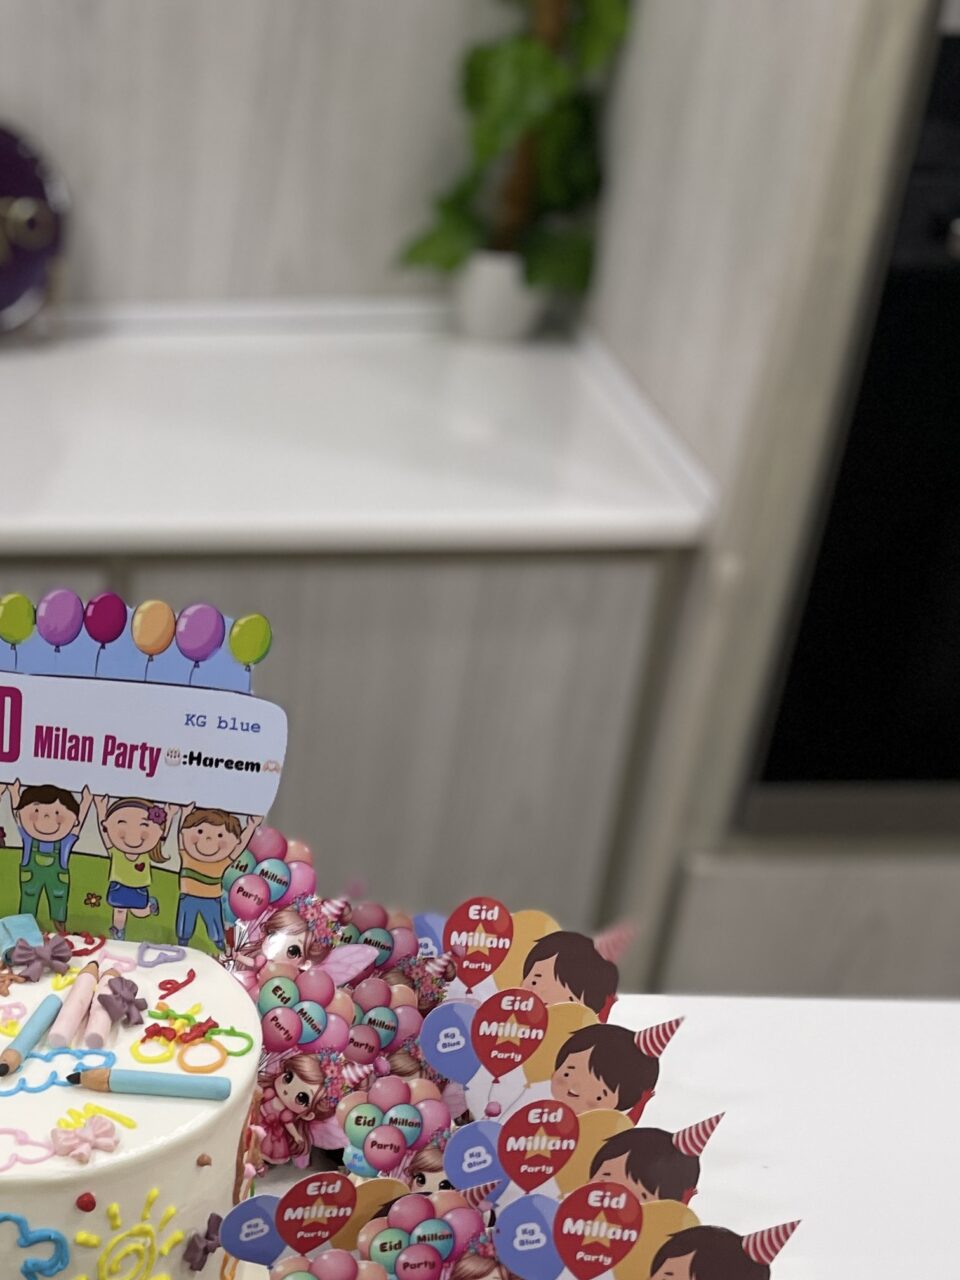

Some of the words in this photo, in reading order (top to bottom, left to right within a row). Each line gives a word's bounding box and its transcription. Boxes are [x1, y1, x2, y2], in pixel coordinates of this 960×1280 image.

[184, 713, 208, 728] KG
[216, 716, 261, 733] blue
[33, 725, 94, 763] Milan
[101, 734, 161, 778] Party
[231, 861, 248, 873] id
[259, 868, 288, 887] Millan
[237, 886, 264, 905] Party
[468, 904, 499, 921] Eid
[340, 934, 353, 944] id
[363, 937, 392, 951] Millan
[450, 930, 510, 949] Millan
[462, 960, 492, 972] Party
[271, 985, 291, 1005] Eid
[297, 1008, 322, 1035] Millan
[501, 995, 535, 1012] Eid
[270, 1015, 293, 1042] Party
[367, 1018, 397, 1032] Millan
[479, 1020, 544, 1040] Millan
[348, 1038, 375, 1054] Party
[490, 1050, 522, 1062] Party
[355, 1115, 376, 1127] Eid
[388, 1116, 421, 1128] Millan
[527, 1106, 564, 1124] Eid
[370, 1140, 400, 1153] Party
[506, 1135, 576, 1152] Millan
[520, 1164, 554, 1175] Party
[306, 1180, 342, 1196] Eid
[587, 1189, 627, 1209] Eid
[283, 1206, 352, 1221] Millan
[296, 1230, 329, 1239] Party
[562, 1217, 638, 1242] Millan
[380, 1240, 403, 1253] Eid
[416, 1233, 453, 1243] Millan
[402, 1261, 436, 1270] Party
[575, 1251, 613, 1266] Party
